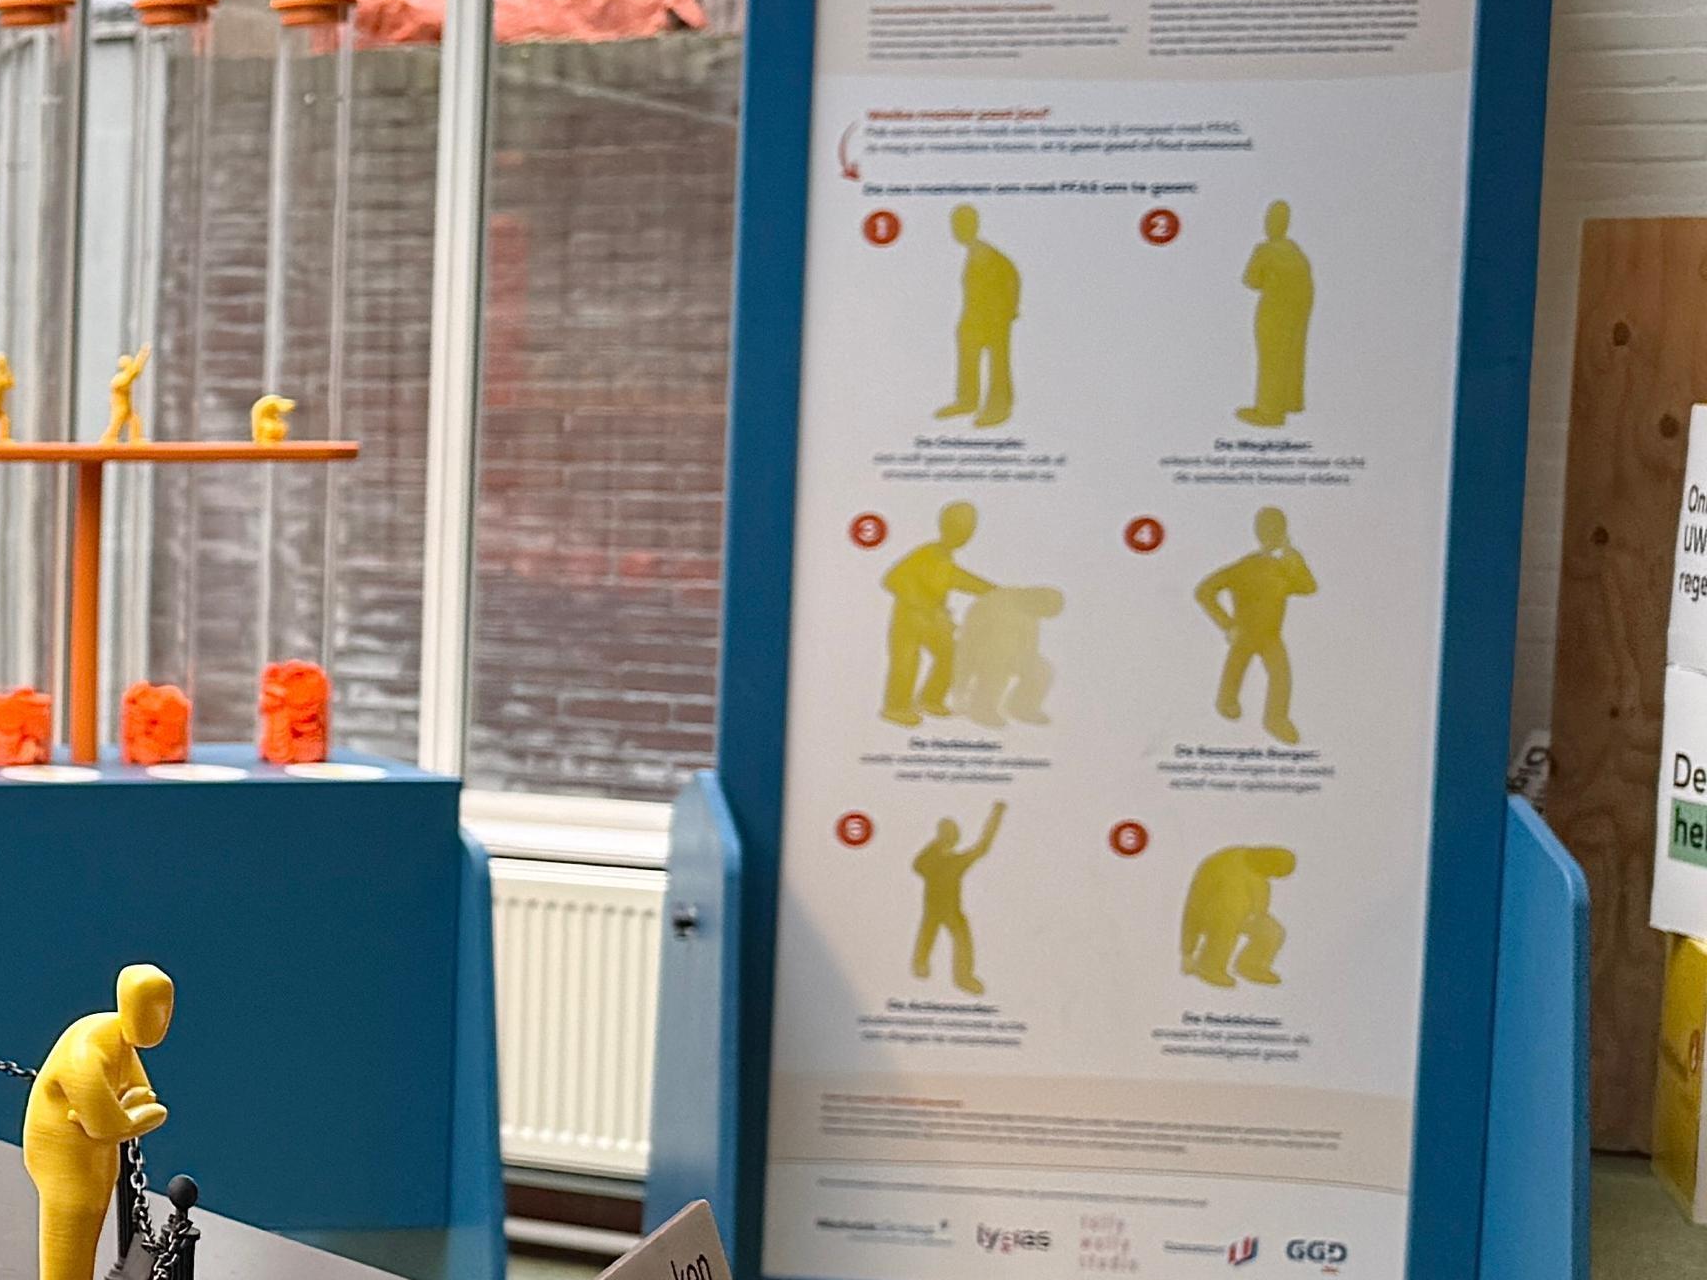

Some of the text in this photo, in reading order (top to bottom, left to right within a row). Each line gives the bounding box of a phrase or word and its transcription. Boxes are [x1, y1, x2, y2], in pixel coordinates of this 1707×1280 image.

[1688, 484, 1707, 514] On
[1673, 805, 1707, 851] he
[1285, 1239, 1348, 1262] GGD
